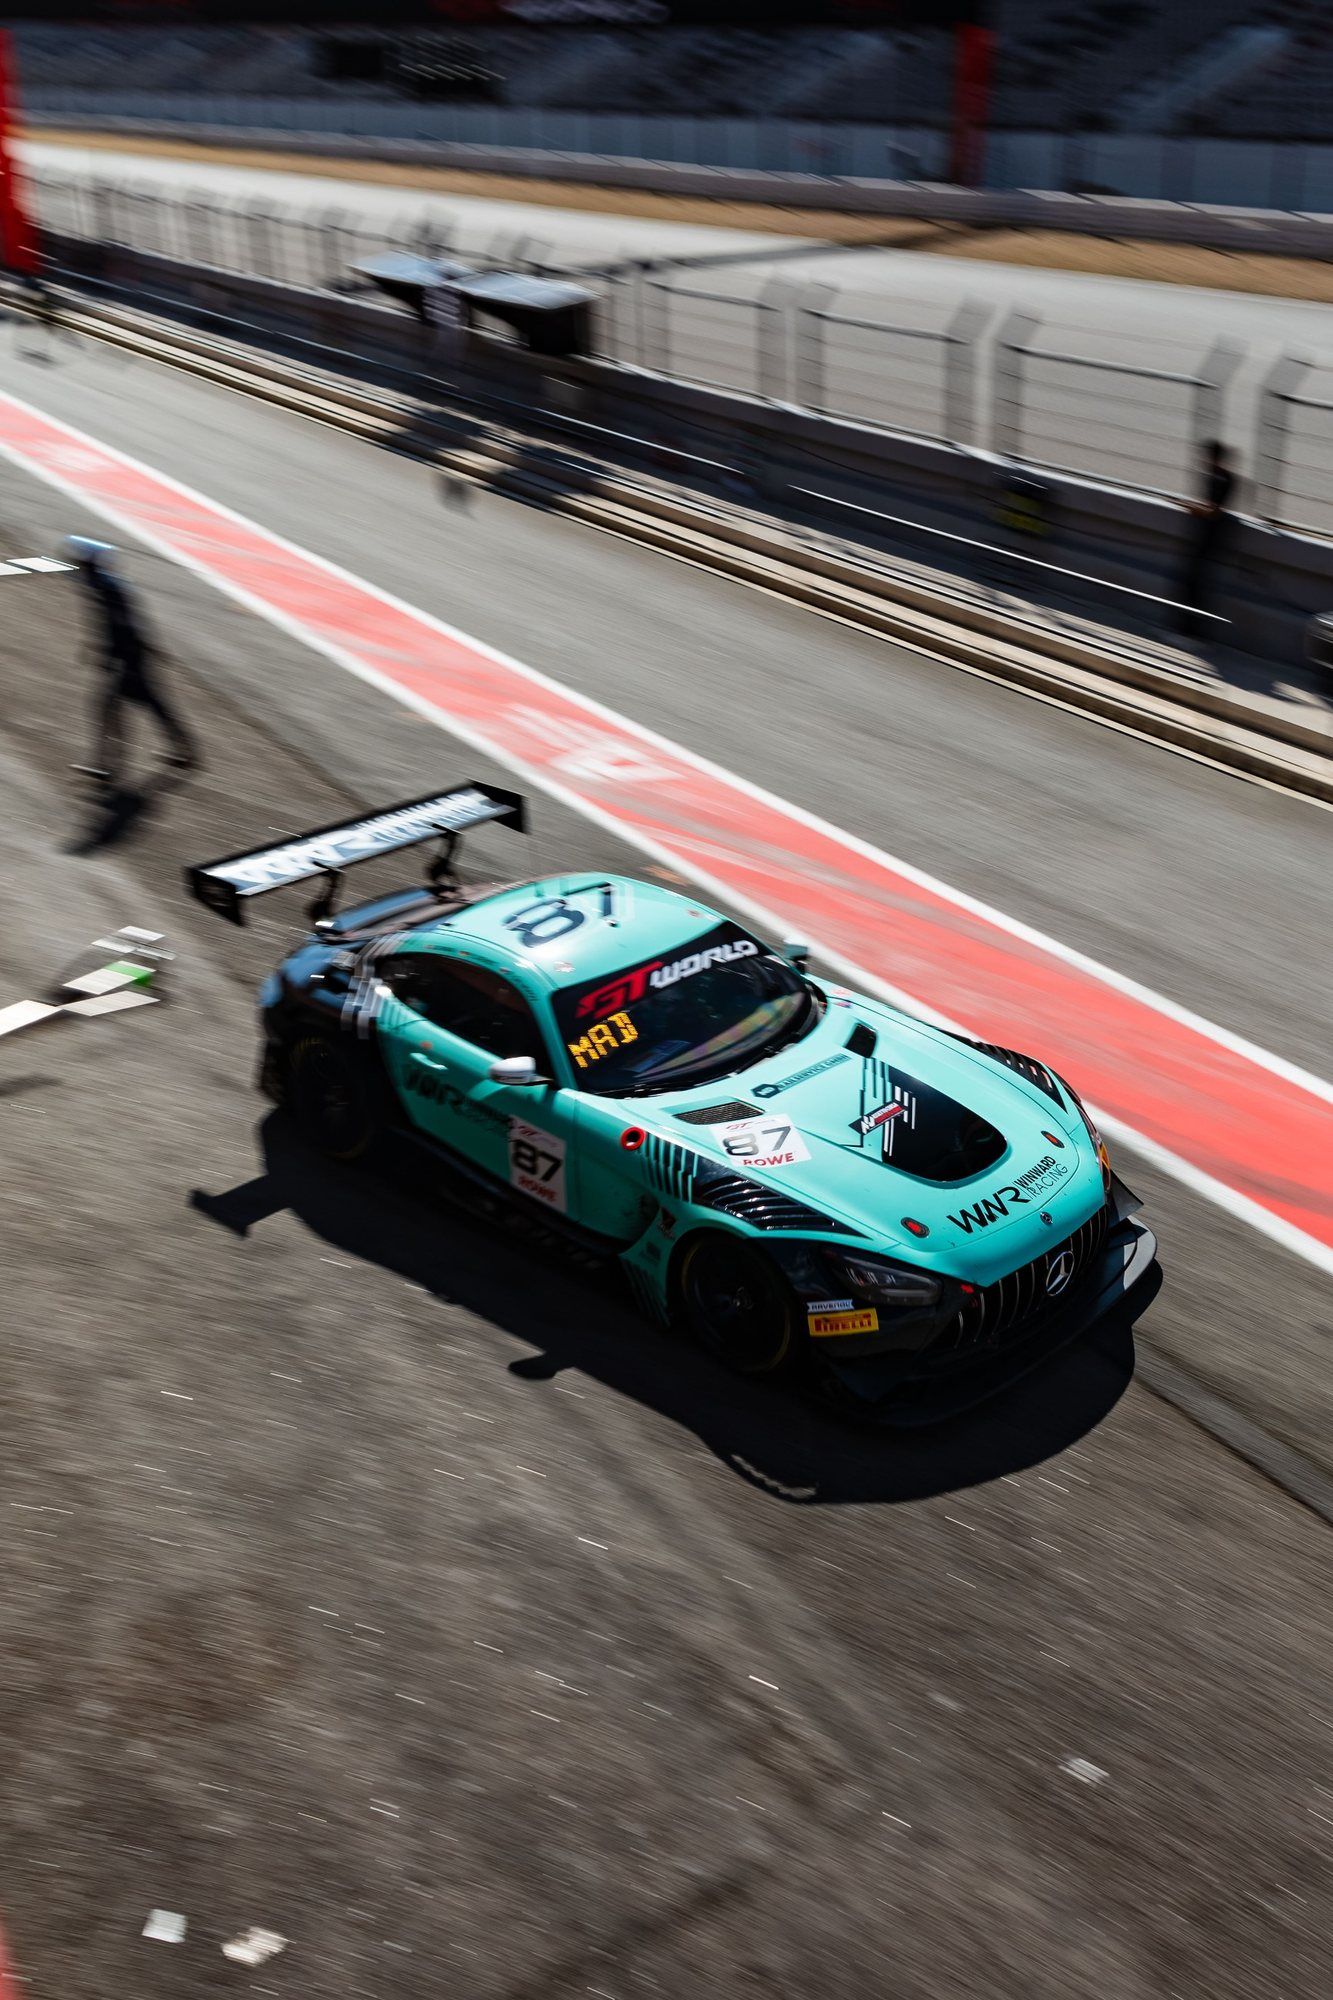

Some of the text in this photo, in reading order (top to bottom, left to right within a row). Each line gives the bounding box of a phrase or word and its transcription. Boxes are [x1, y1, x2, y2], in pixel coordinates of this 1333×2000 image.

[502, 881, 615, 949] 87
[575, 961, 664, 1019] GT
[649, 940, 758, 989] WORLD
[723, 1126, 791, 1156] 87
[513, 1140, 562, 1182] 87
[743, 1152, 794, 1166] ROWE
[1014, 1155, 1056, 1189] WINWARD
[1026, 1163, 1068, 1198] RACING
